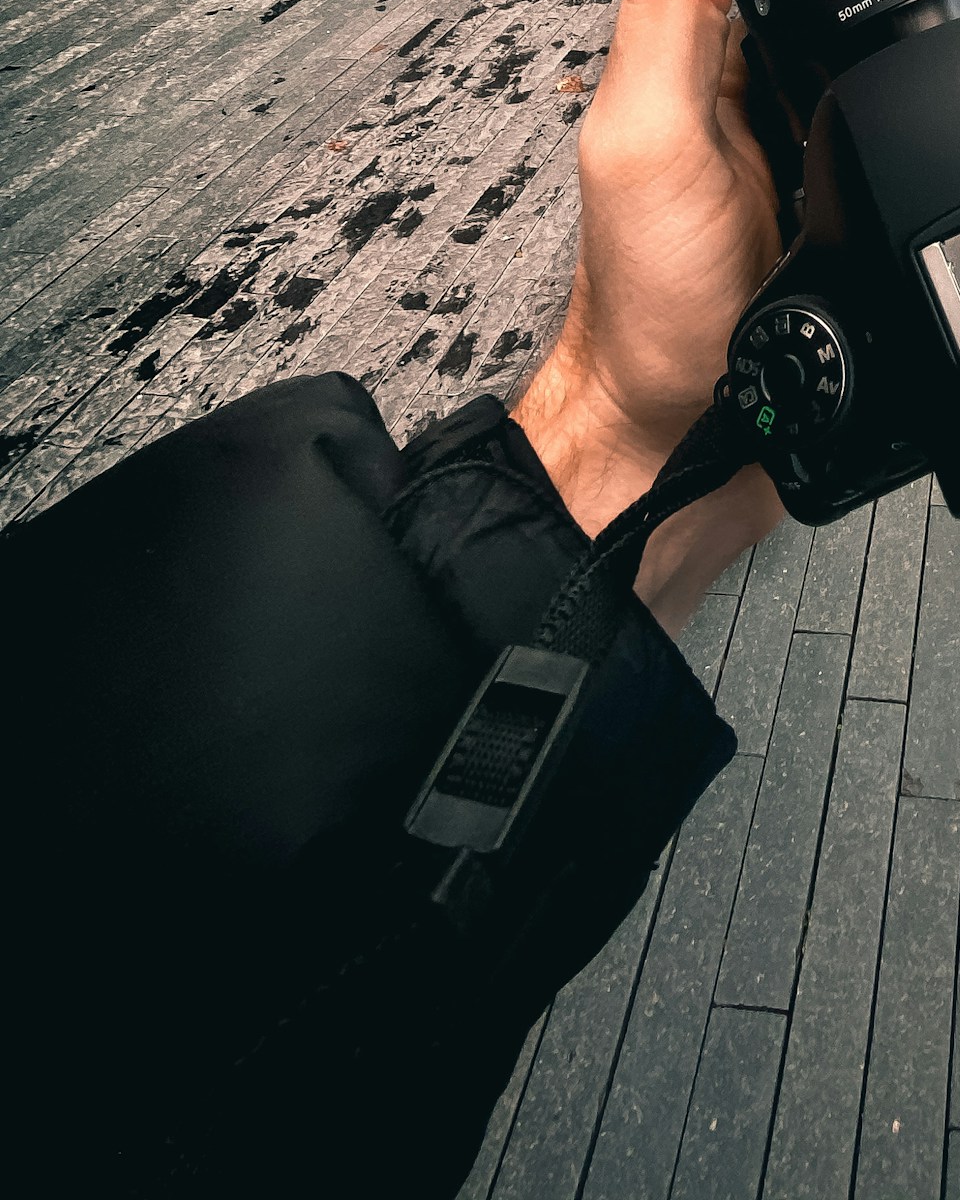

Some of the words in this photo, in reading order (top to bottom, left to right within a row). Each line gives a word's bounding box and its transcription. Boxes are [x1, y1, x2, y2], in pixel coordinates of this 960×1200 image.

[800, 322, 816, 339] B
[817, 343, 836, 365] M
[816, 375, 841, 396] Av
